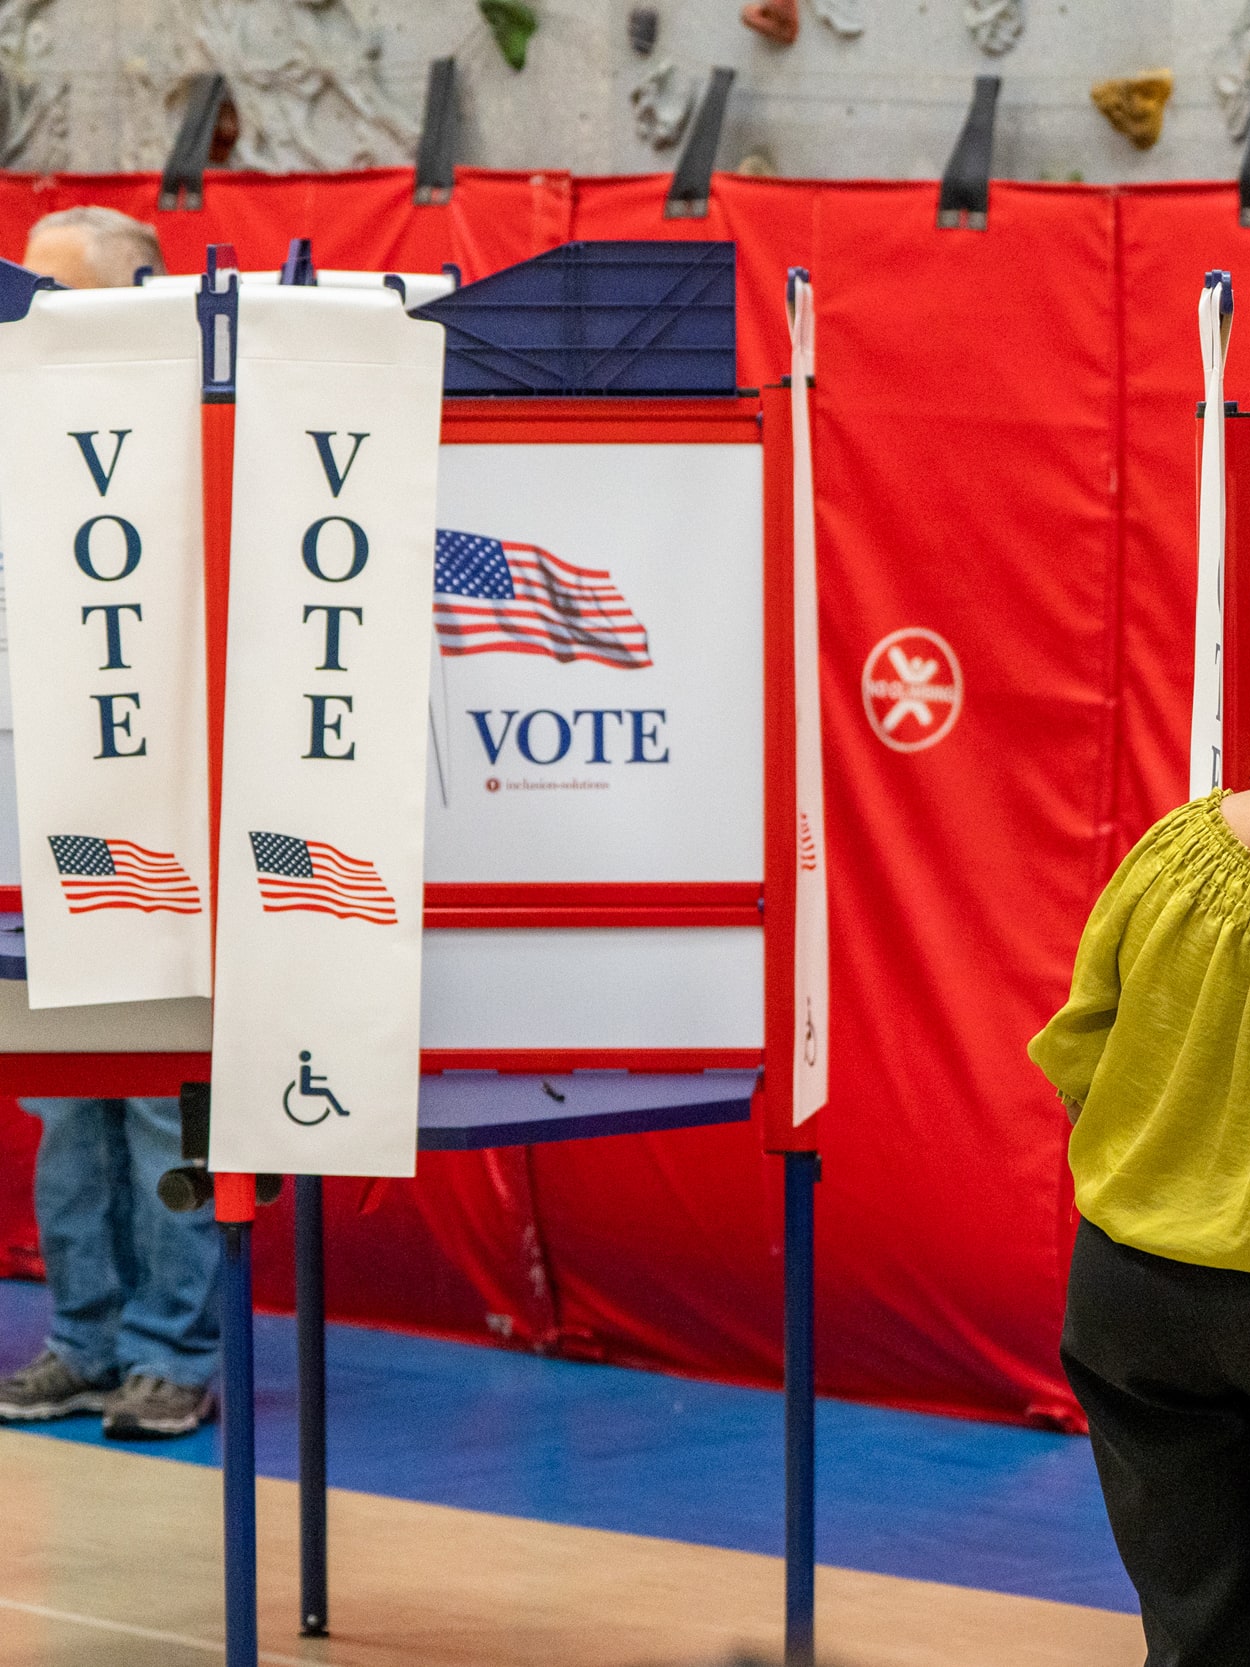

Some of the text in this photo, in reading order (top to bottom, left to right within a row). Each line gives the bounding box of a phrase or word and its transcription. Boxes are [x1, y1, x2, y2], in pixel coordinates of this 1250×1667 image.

[67, 429, 147, 760] VOTE
[301, 430, 371, 761] VOTE
[466, 708, 670, 766] VOTE
